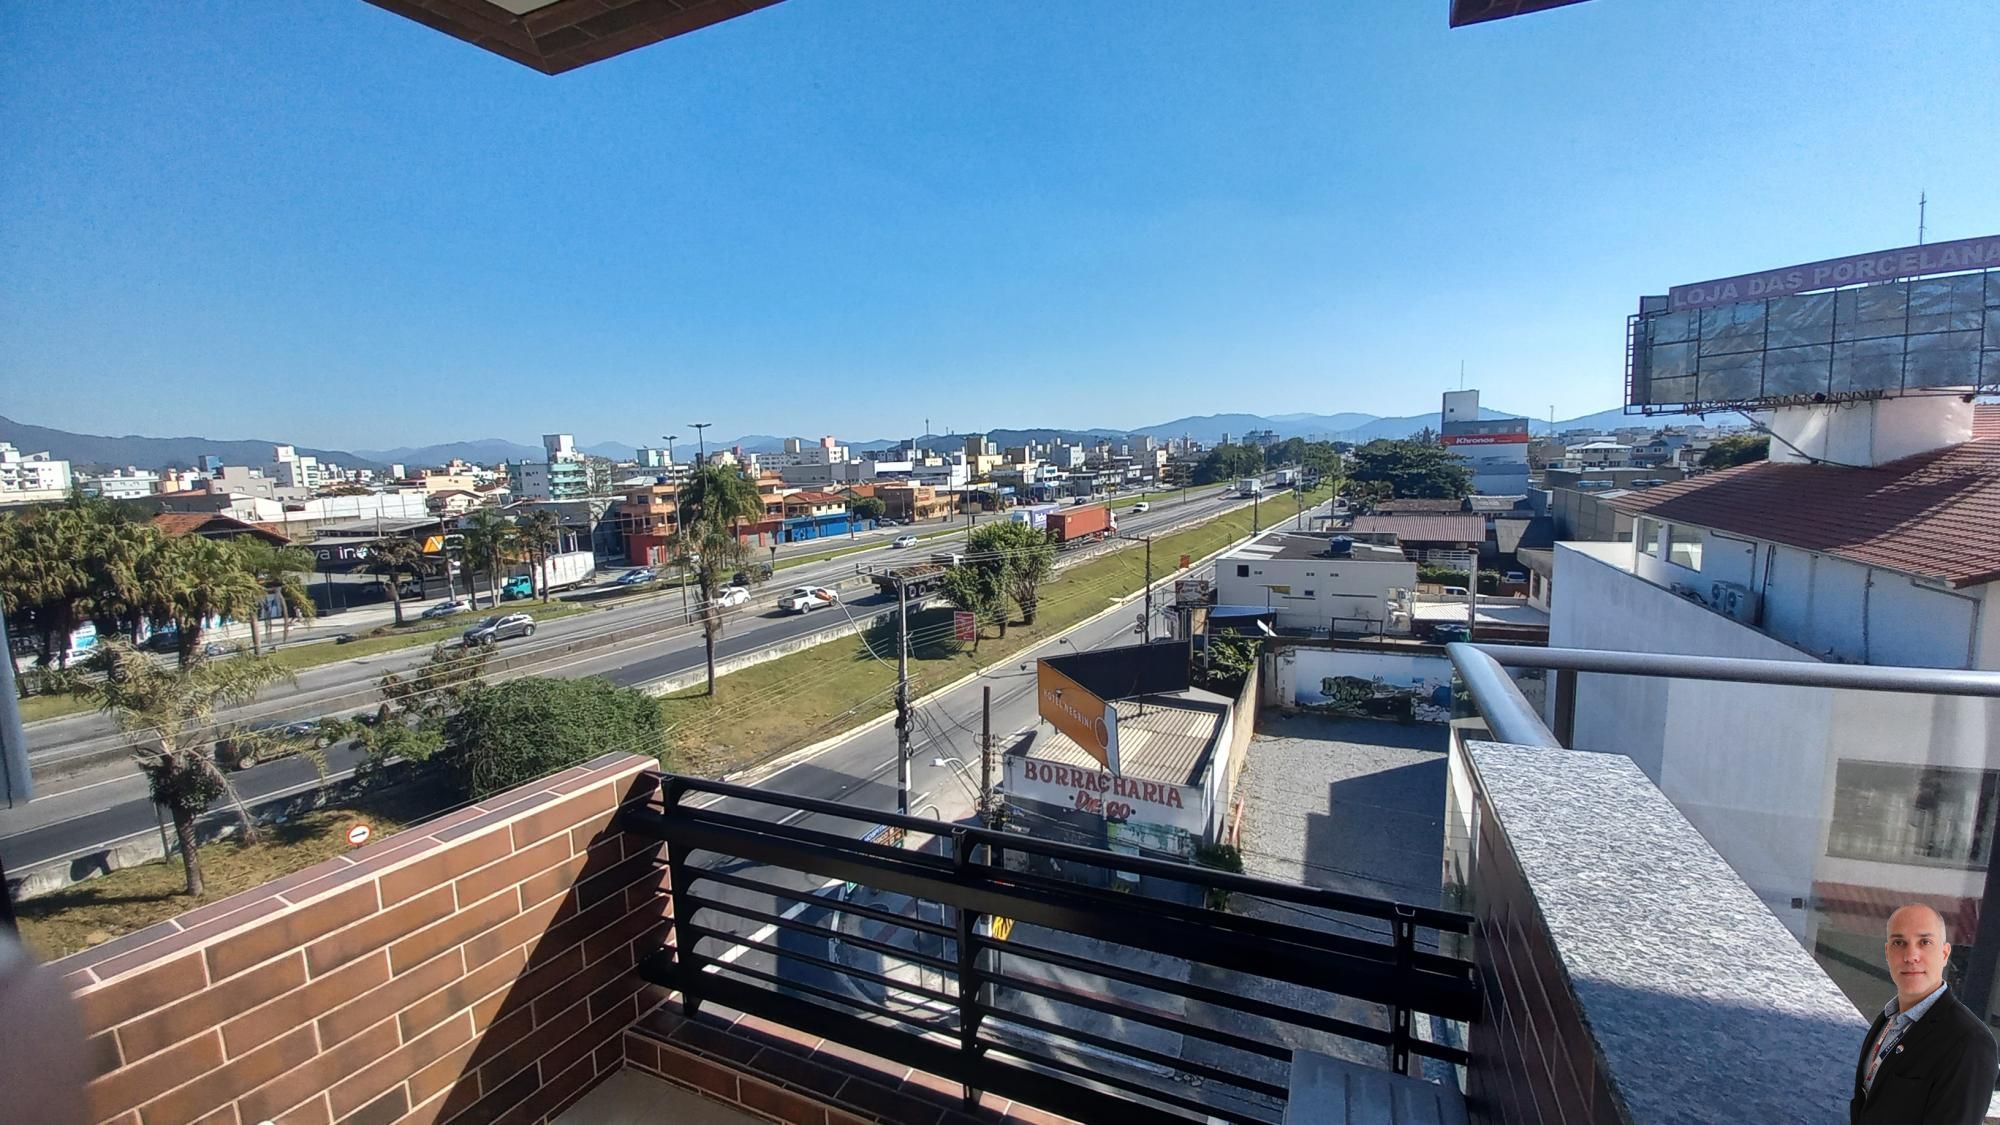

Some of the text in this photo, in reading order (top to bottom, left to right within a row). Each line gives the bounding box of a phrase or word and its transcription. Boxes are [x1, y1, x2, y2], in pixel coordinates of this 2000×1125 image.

[1673, 241, 2000, 306] LOJA DAS PORCELANA
[1456, 437, 1495, 445] Khronos
[1043, 687, 1063, 709] HOTEL
[1024, 760, 1184, 809] BORRACHARIA
